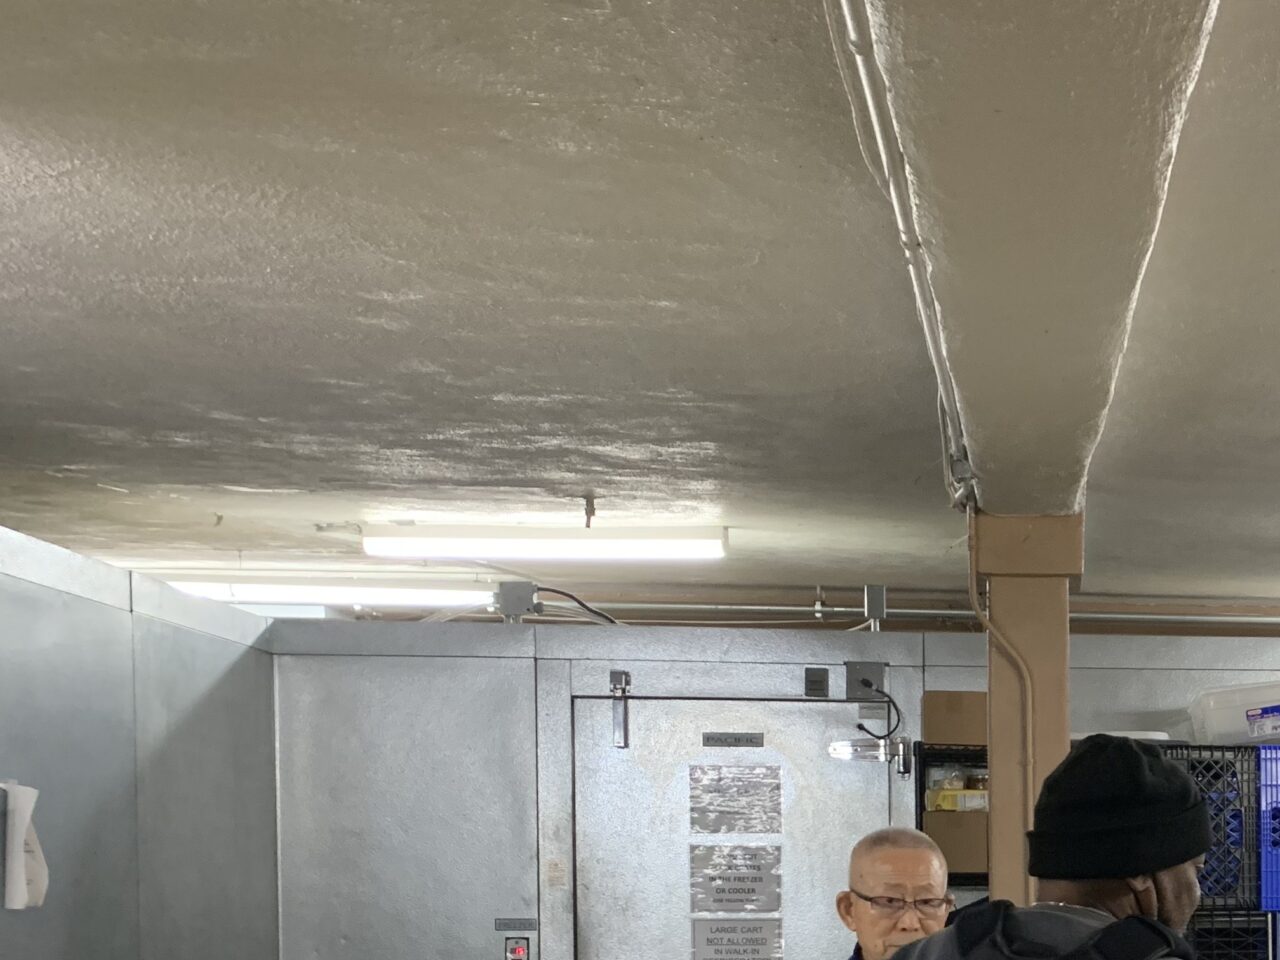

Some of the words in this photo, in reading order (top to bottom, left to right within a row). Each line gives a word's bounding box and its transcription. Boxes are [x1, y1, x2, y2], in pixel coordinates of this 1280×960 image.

[705, 735, 758, 745] PACIFIC
[709, 926, 739, 934] LARGE
[740, 926, 764, 934] CART
[706, 937, 724, 945] NOT
[727, 937, 768, 945] ALLOWED
